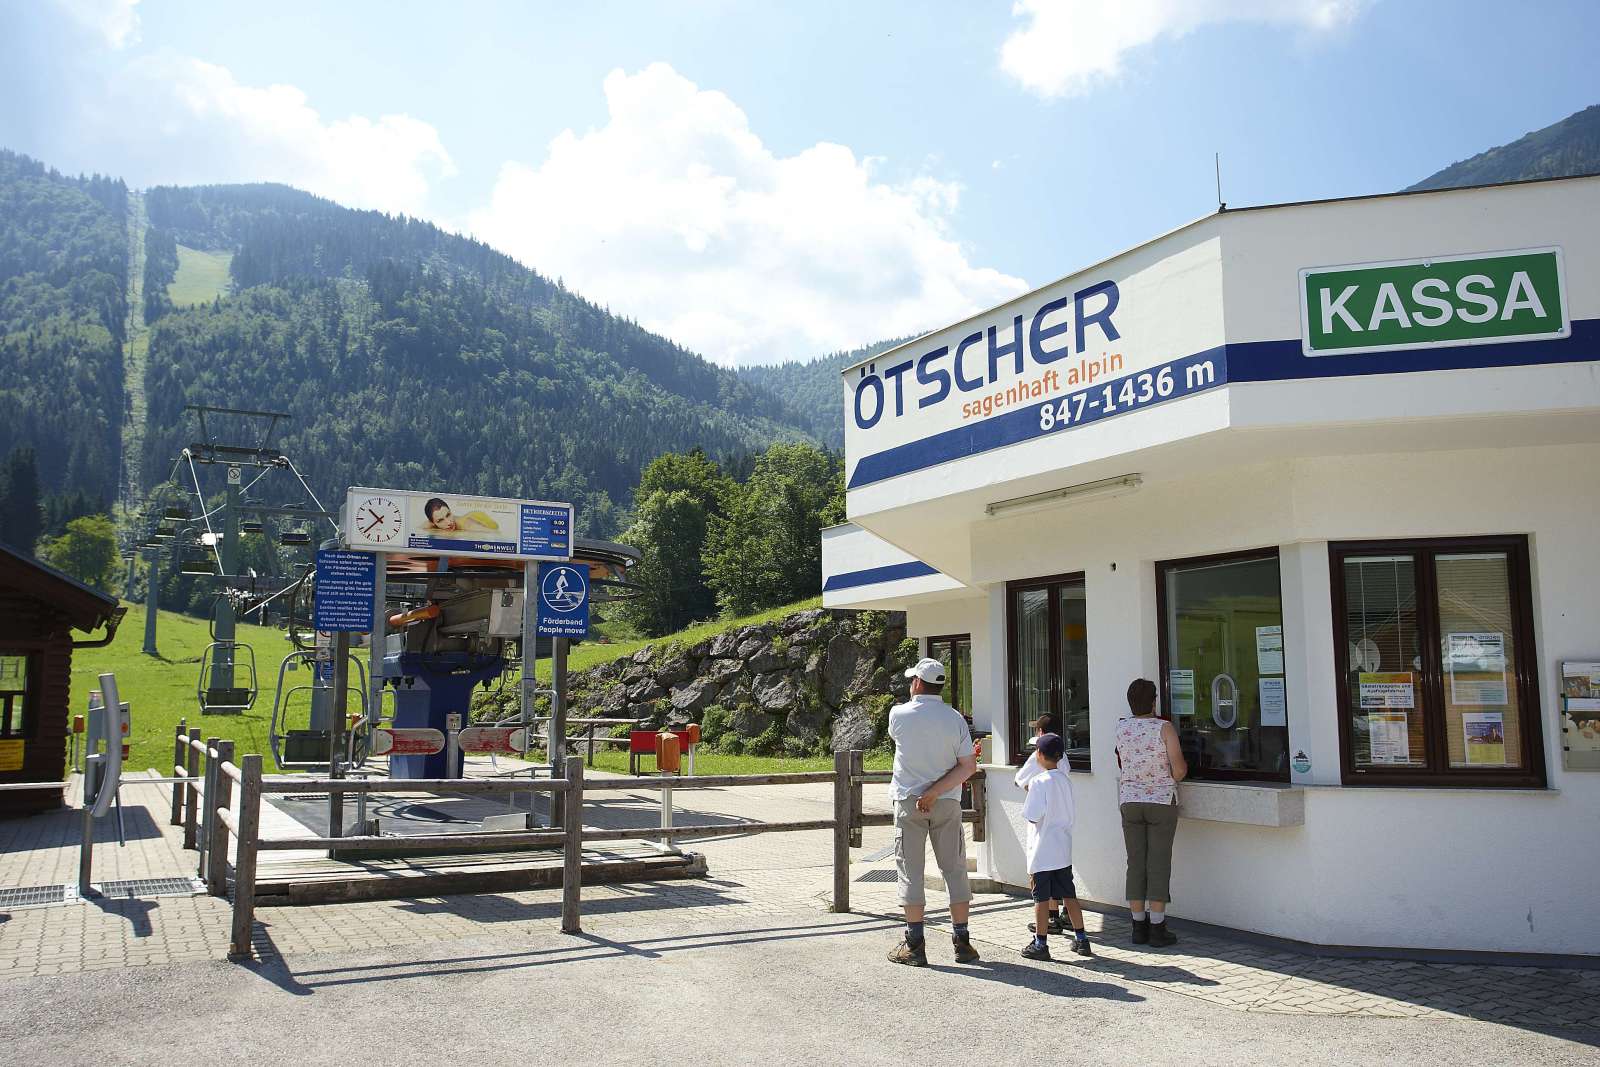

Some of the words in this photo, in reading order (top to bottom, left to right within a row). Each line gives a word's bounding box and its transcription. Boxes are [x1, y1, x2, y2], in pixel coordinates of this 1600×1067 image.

[1320, 270, 1547, 335] KASSA
[854, 280, 1121, 431] ÖTSCHER
[961, 371, 1060, 420] sagenhaft
[1067, 353, 1124, 385] alpin
[1038, 367, 1175, 432] 847-1436
[1186, 360, 1216, 390] m
[538, 625, 563, 635] People
[543, 617, 583, 626] Förderband
